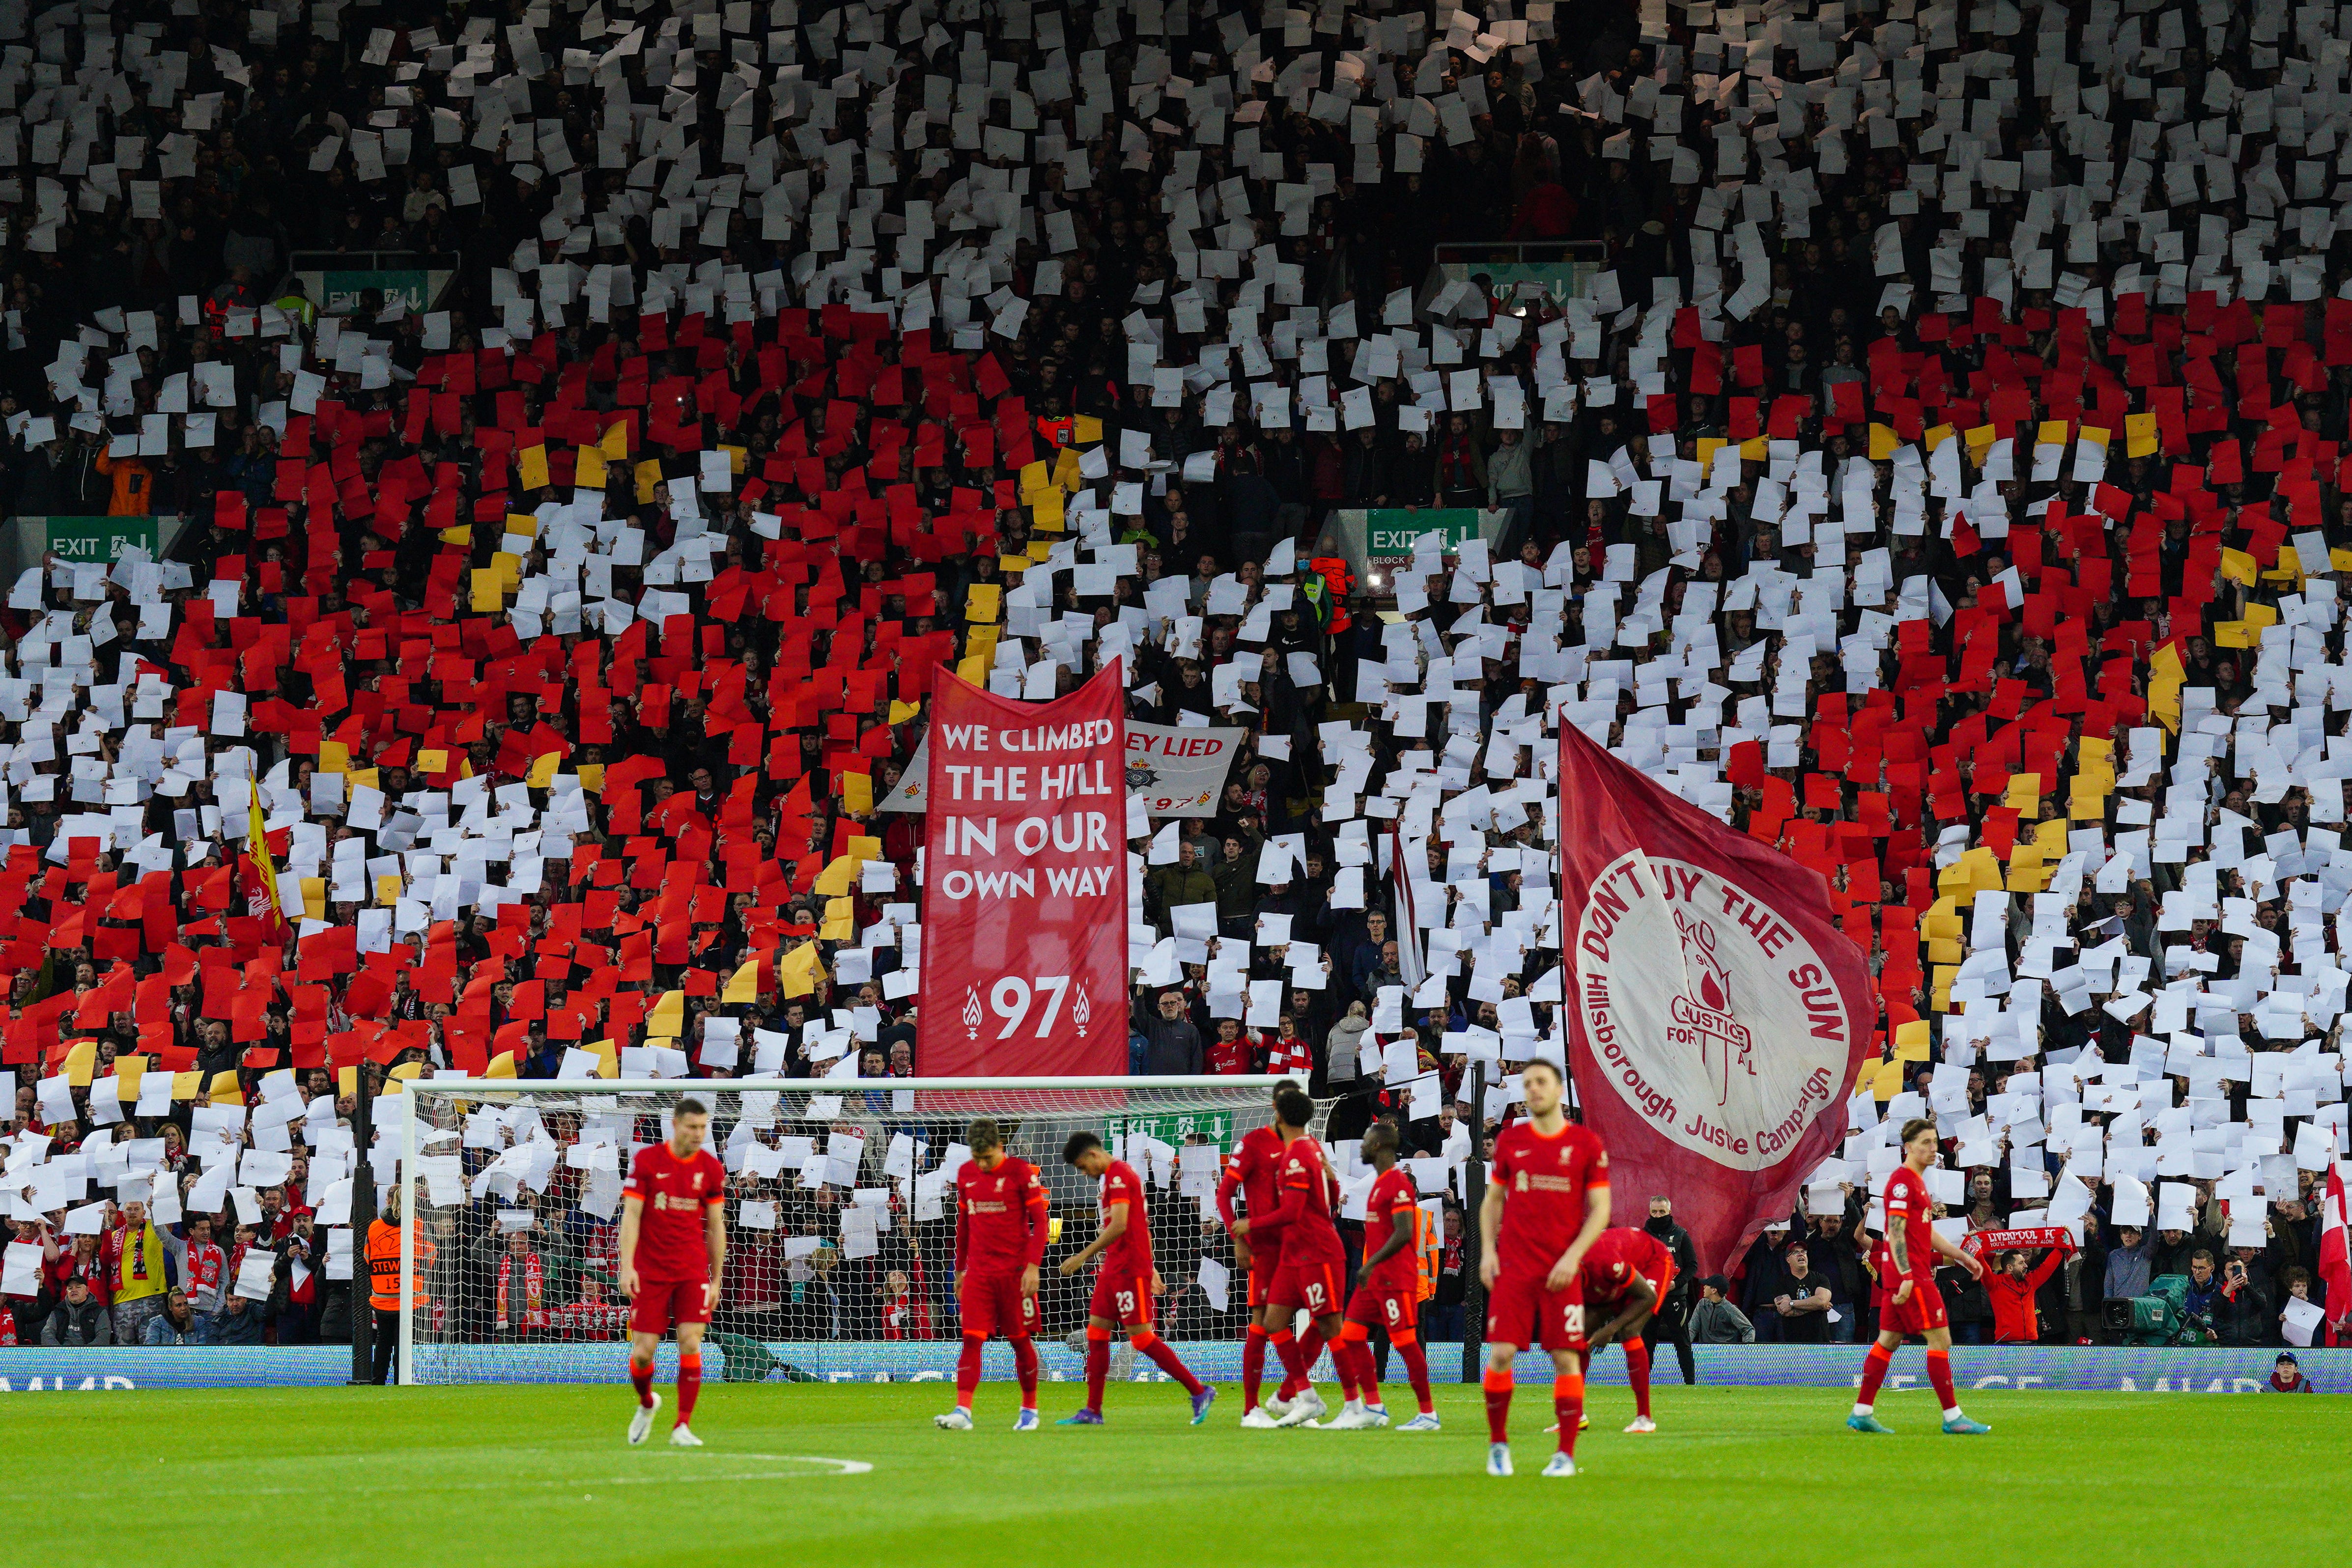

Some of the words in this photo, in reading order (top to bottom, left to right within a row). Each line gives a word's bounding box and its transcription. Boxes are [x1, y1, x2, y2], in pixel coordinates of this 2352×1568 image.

[53, 538, 99, 555] EXIT
[1373, 531, 1419, 548] EXIT
[942, 724, 988, 752] WE
[1000, 719, 1113, 752] CLIMBED
[1125, 732, 1160, 752] EY
[1163, 737, 1223, 757] LIED
[945, 766, 1026, 801] THE
[1041, 760, 1111, 800] HILL
[945, 816, 996, 856] IN
[1015, 812, 1110, 853] OUR
[943, 868, 1034, 900] OWN
[1047, 865, 1114, 897] WAY
[1582, 860, 1645, 963] DON'T
[1649, 865, 1704, 902] UY
[1721, 885, 1794, 959] THE
[1788, 963, 1844, 1041] SUN
[990, 976, 1070, 1040] 97
[1667, 1027, 1698, 1046] FOR
[1587, 973, 1677, 1124] Hillsborough
[1756, 1067, 1832, 1155] Campaign
[1109, 1120, 1160, 1137] EXIT
[1987, 1230, 2038, 1242] LIVERPOOL
[2045, 1229, 2056, 1239] FC
[1116, 1290, 1134, 1313] 23
[1305, 1283, 1326, 1307] 12
[1022, 1297, 1035, 1318] 9
[1386, 1298, 1400, 1320] 8
